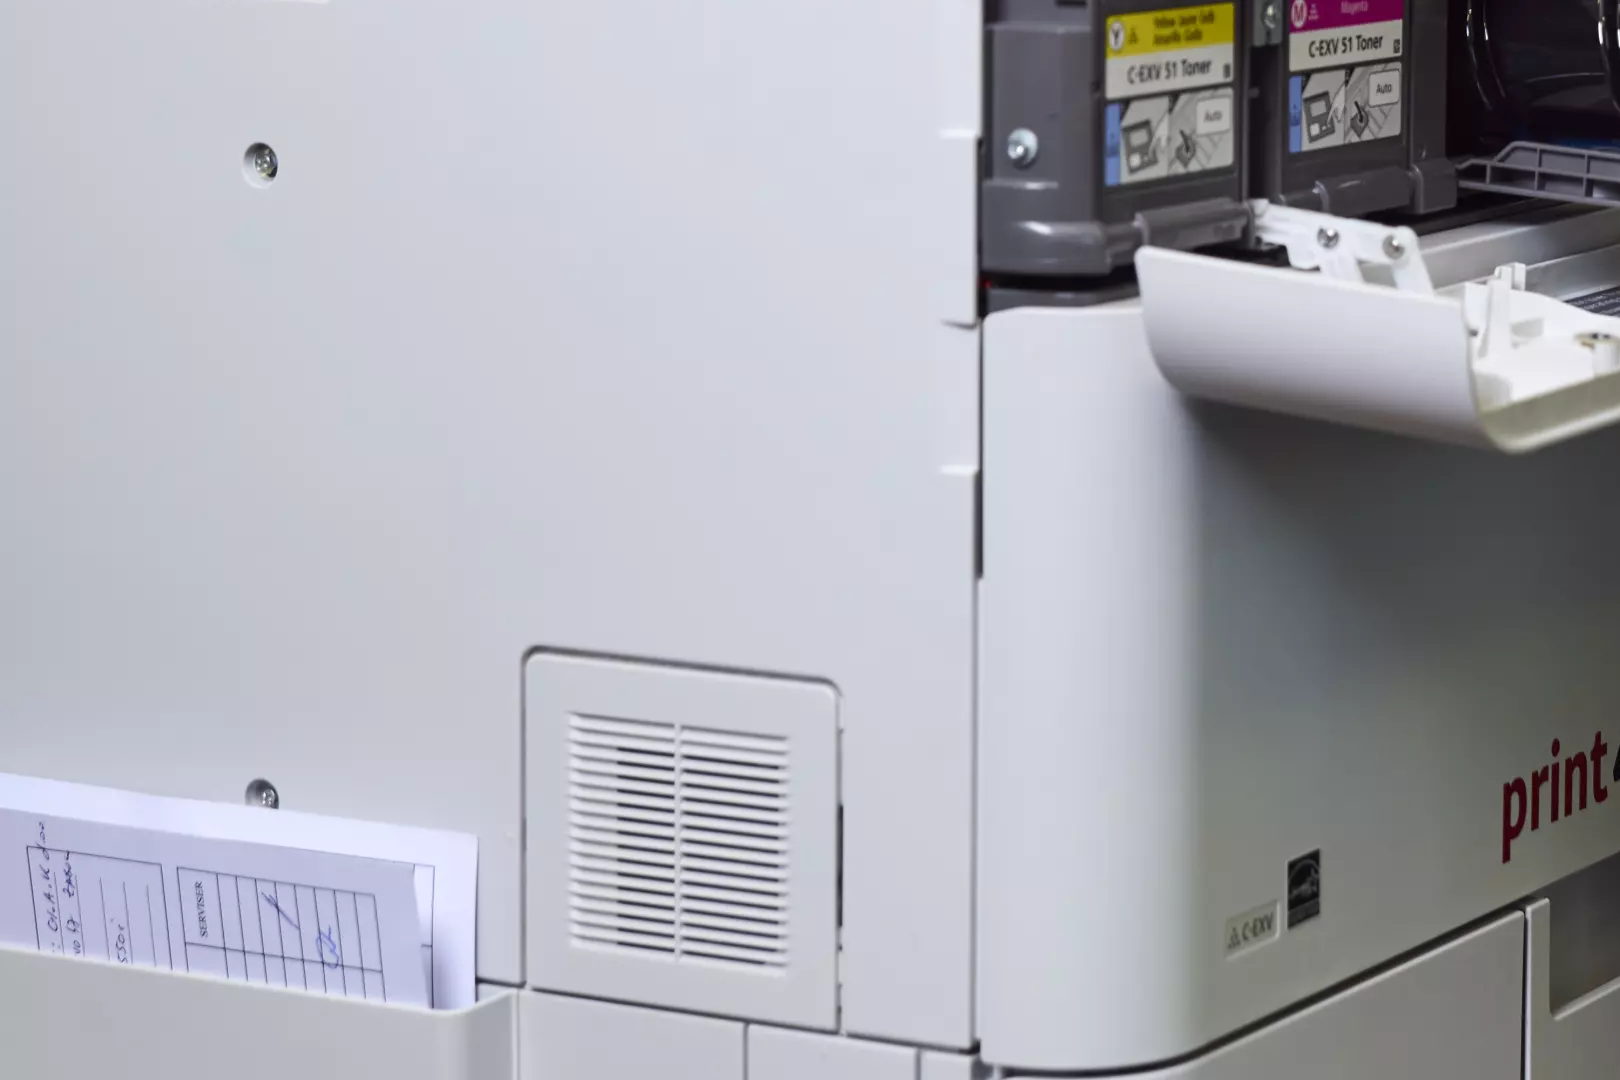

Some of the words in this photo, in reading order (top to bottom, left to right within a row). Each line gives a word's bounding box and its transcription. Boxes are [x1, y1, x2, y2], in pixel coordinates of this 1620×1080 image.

[1308, 38, 1339, 58] C-EXV
[1341, 36, 1353, 53] 51
[1355, 34, 1384, 51] Toner
[1127, 62, 1161, 84] C-EXV
[1164, 61, 1177, 80] 51
[1181, 58, 1212, 77] Toner
[194, 881, 208, 938] SERVISER
